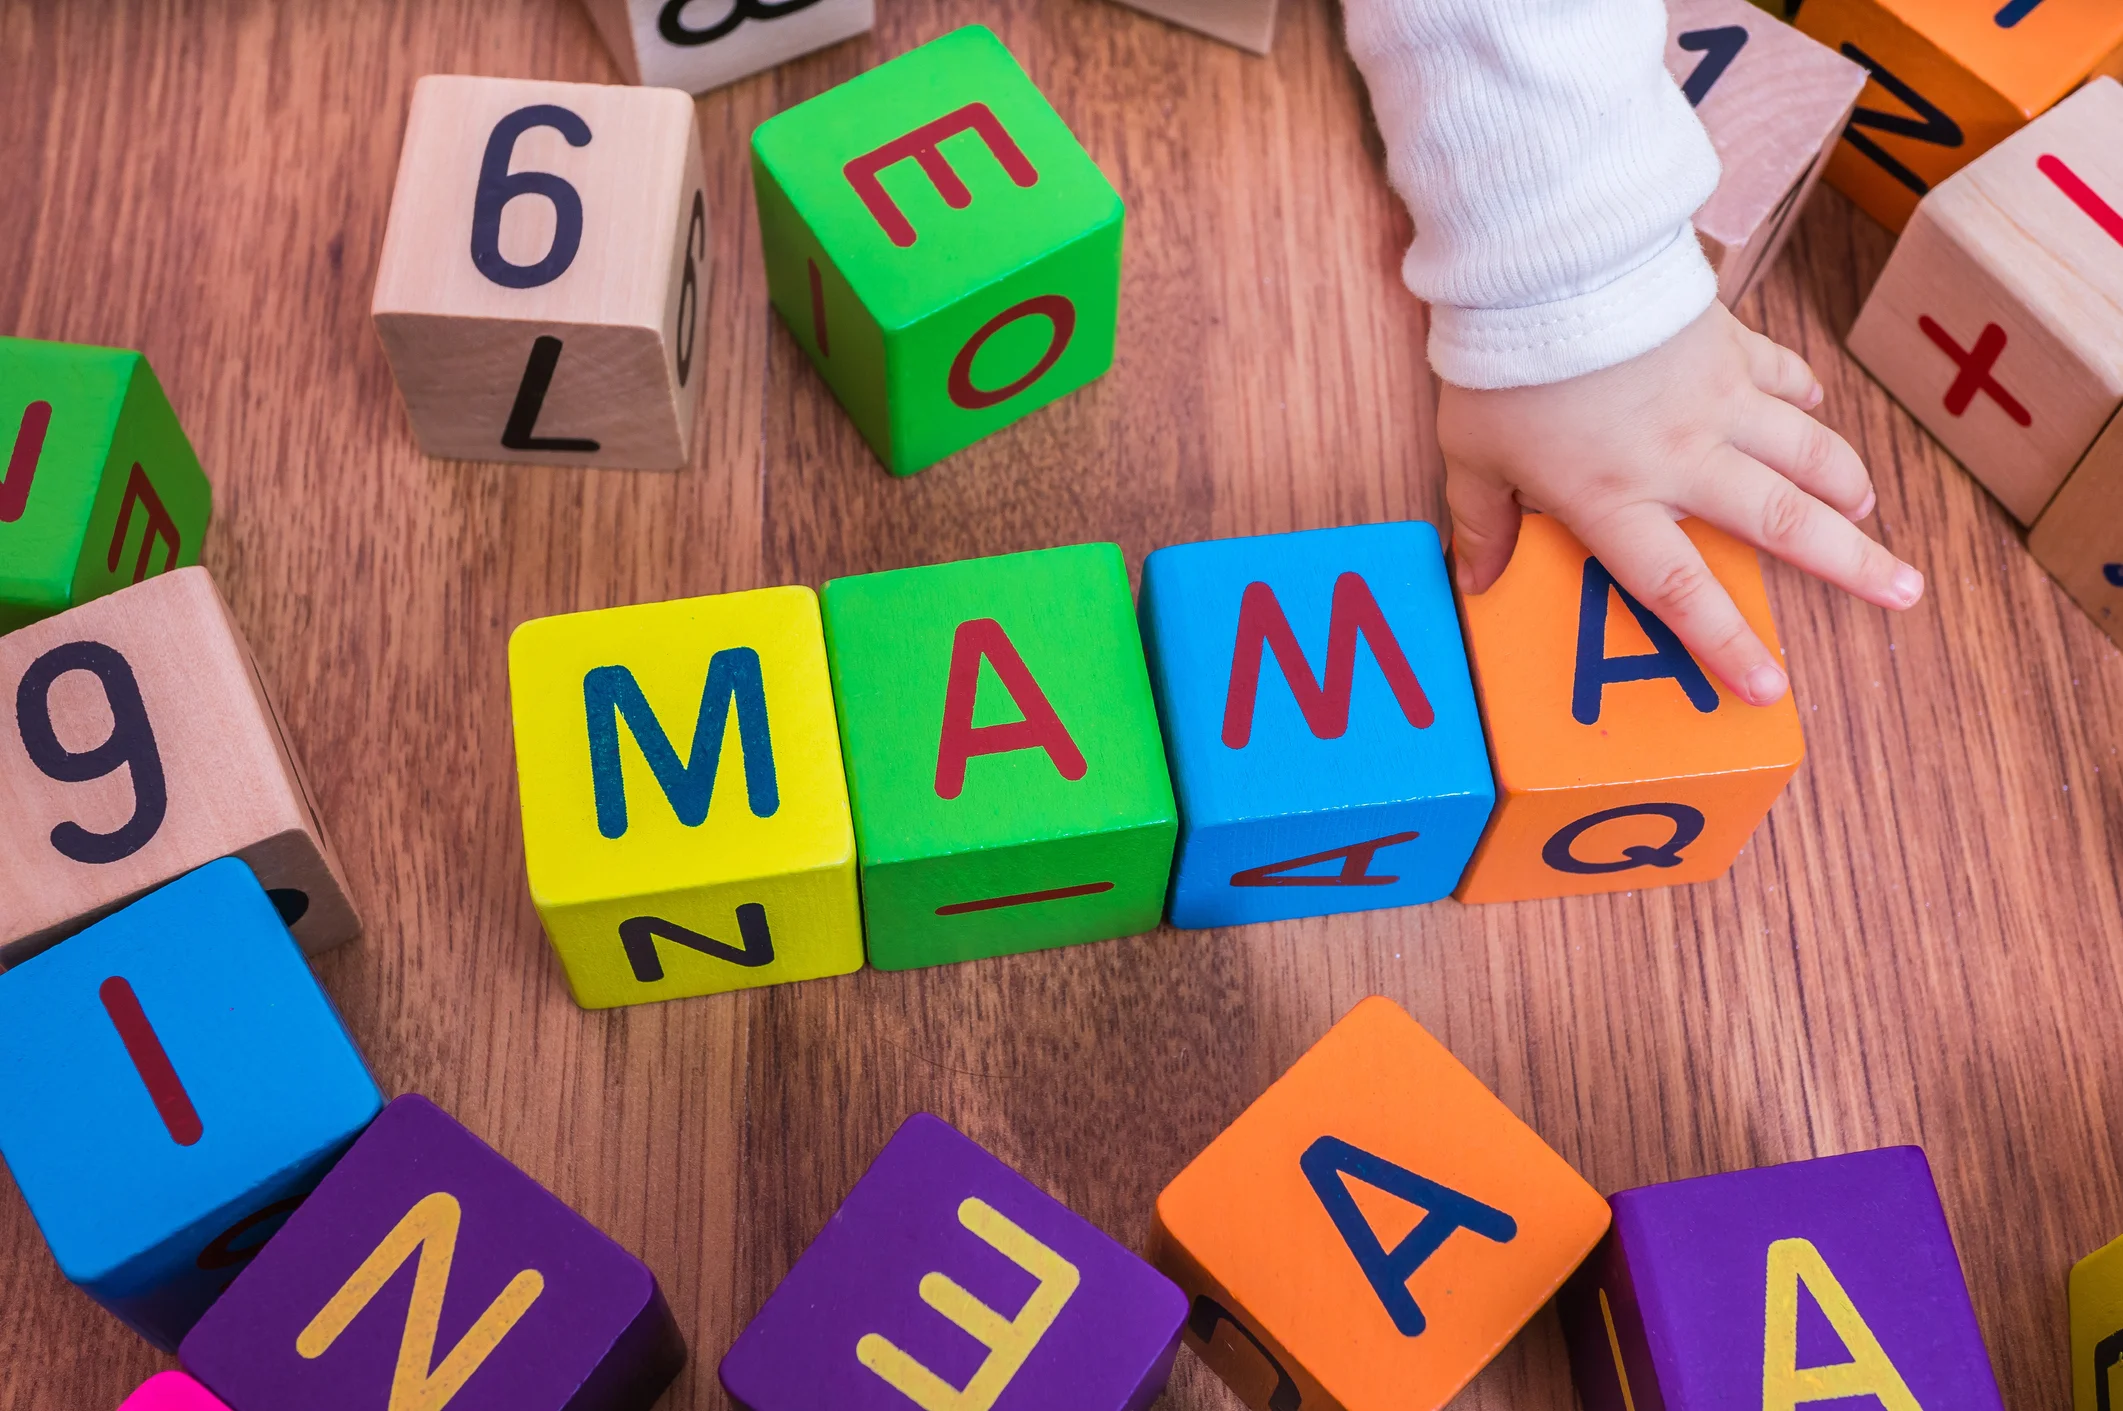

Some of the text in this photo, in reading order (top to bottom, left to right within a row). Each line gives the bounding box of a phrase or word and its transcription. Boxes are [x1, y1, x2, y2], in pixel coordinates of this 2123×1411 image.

[471, 104, 592, 289] 6
[843, 102, 1039, 247] E
[948, 294, 1076, 410] O
[16, 640, 168, 864] 9
[1542, 802, 1705, 874] Q
[1229, 830, 1420, 888] A
[856, 1196, 1081, 1411] E
[1300, 1135, 1517, 1337] A
[1762, 1237, 1924, 1411] A
